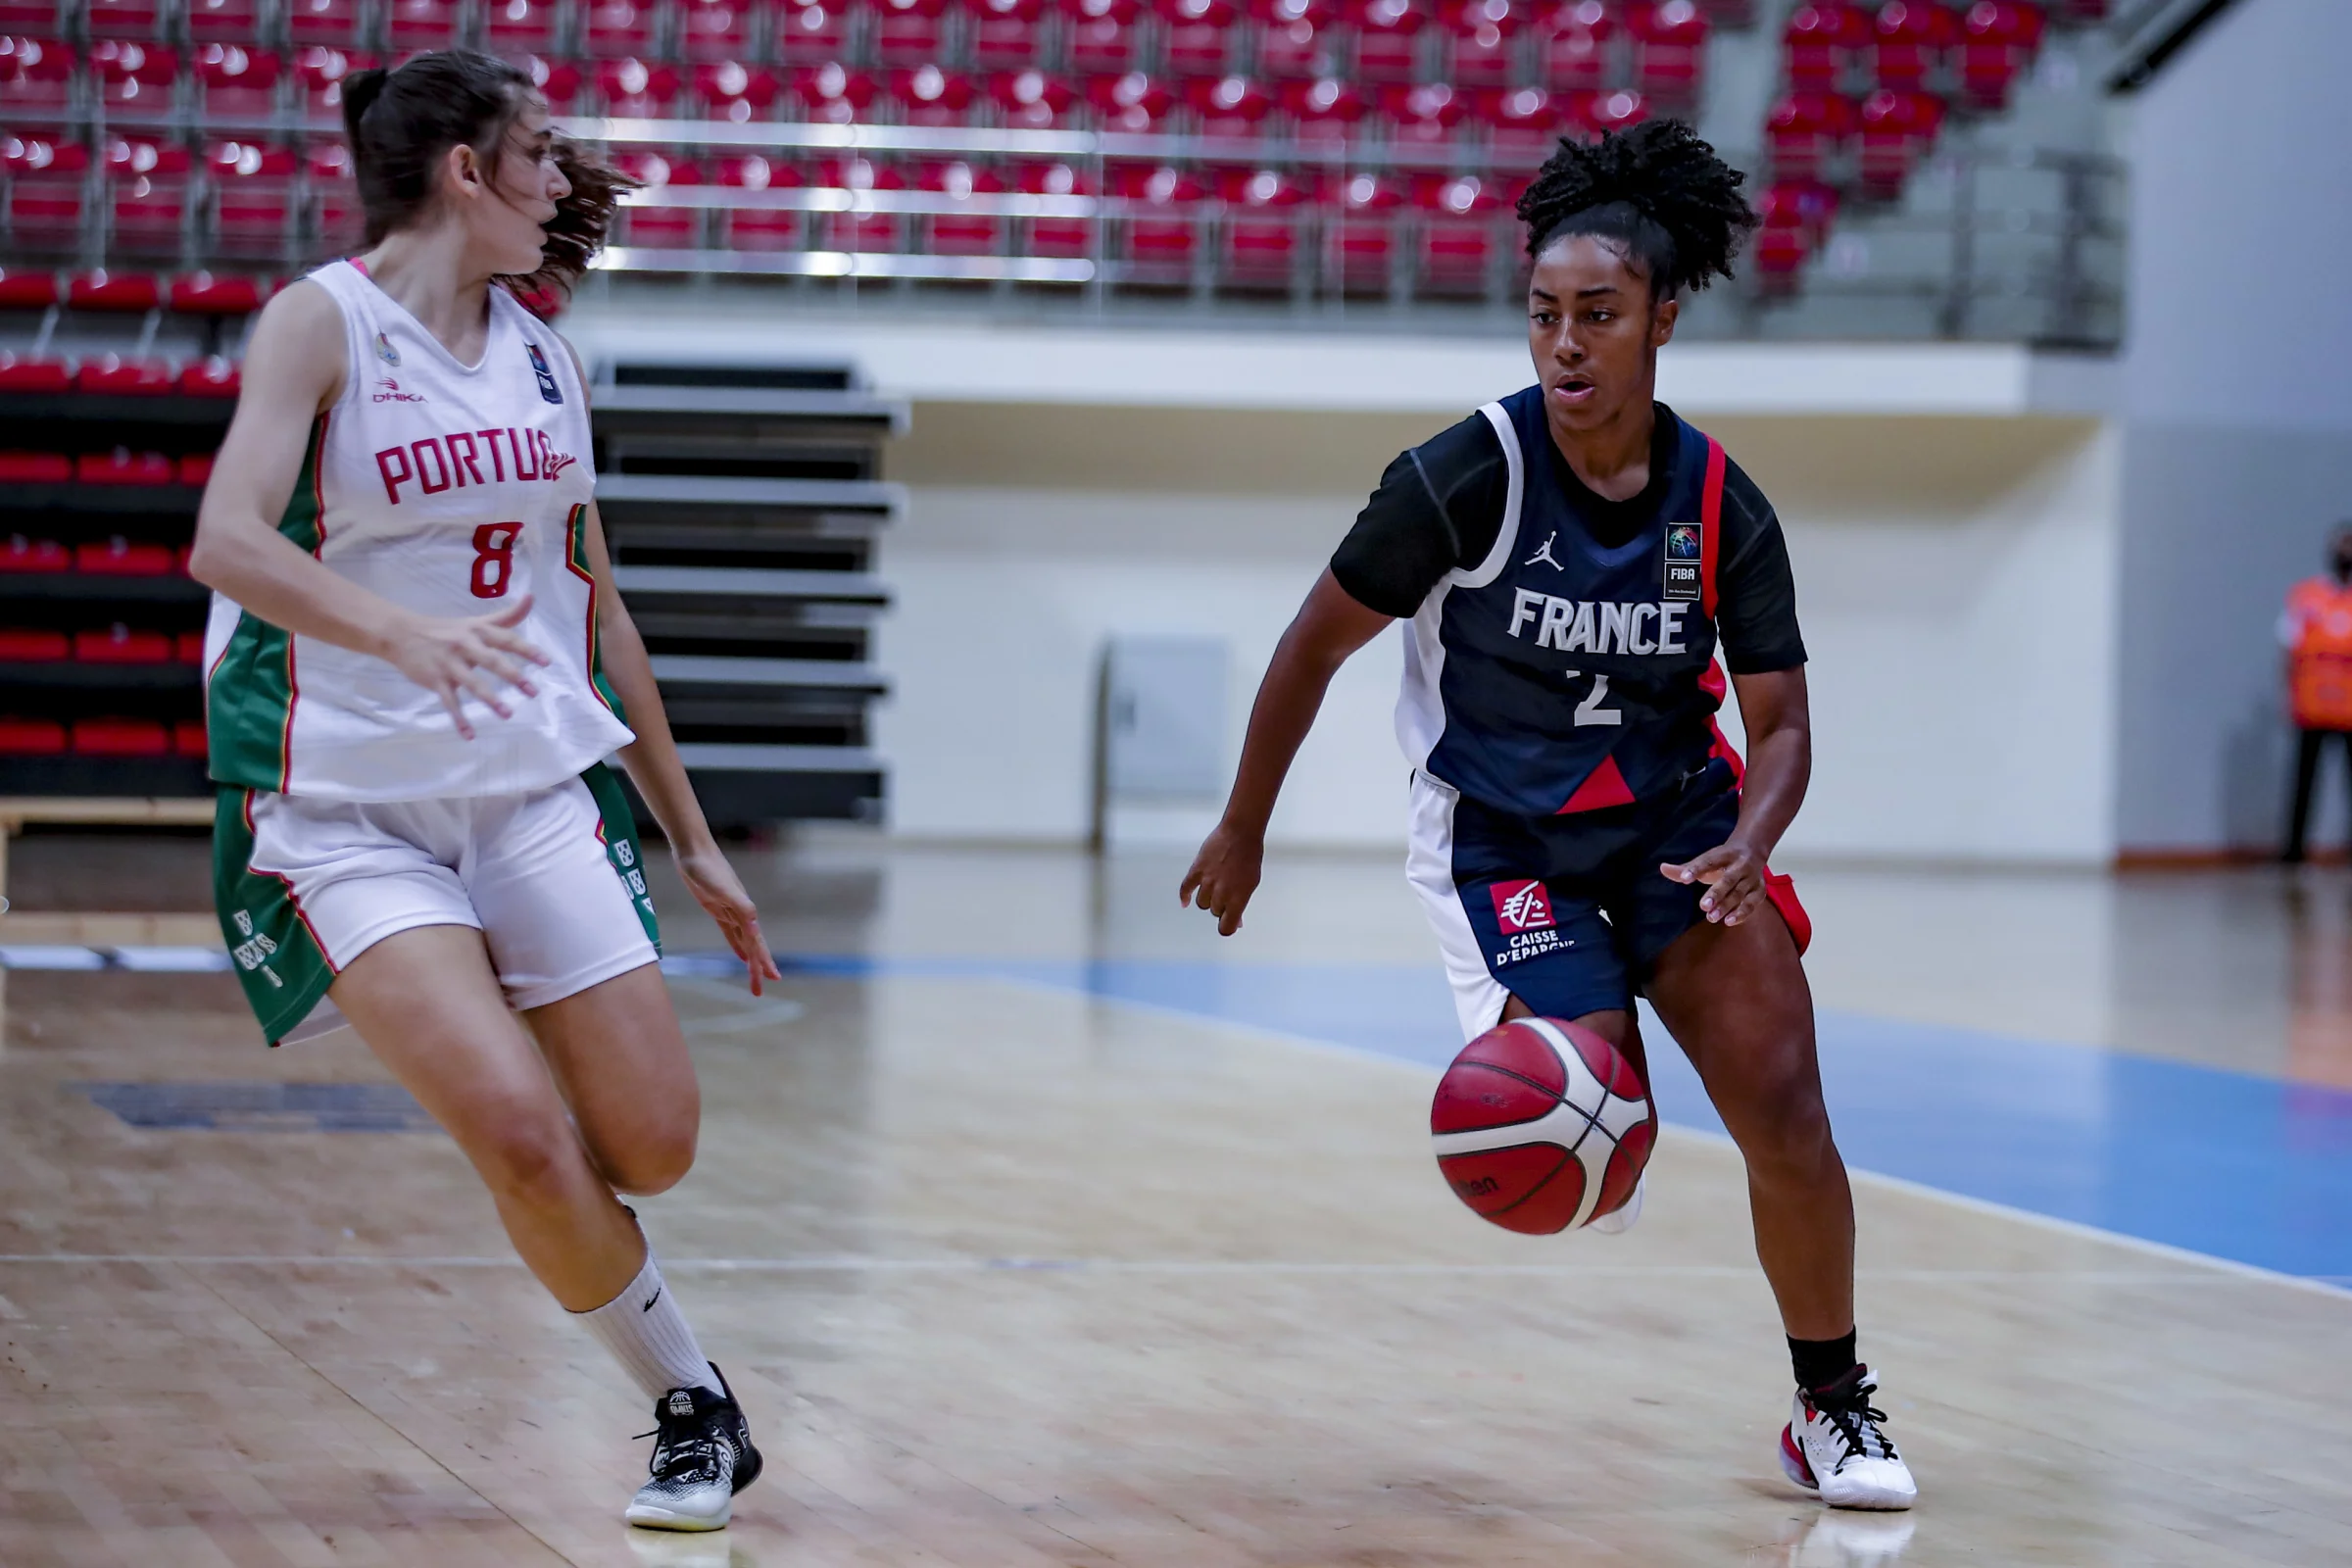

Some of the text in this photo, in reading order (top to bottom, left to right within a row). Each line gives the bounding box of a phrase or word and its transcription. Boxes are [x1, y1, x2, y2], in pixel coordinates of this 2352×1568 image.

[372, 392, 428, 403] DHIKA
[470, 521, 524, 599] 8
[1670, 567, 1695, 580] FIBA
[1506, 586, 1690, 656] FRANCE
[1565, 669, 1622, 727] 2
[1509, 929, 1559, 949] CAISSE
